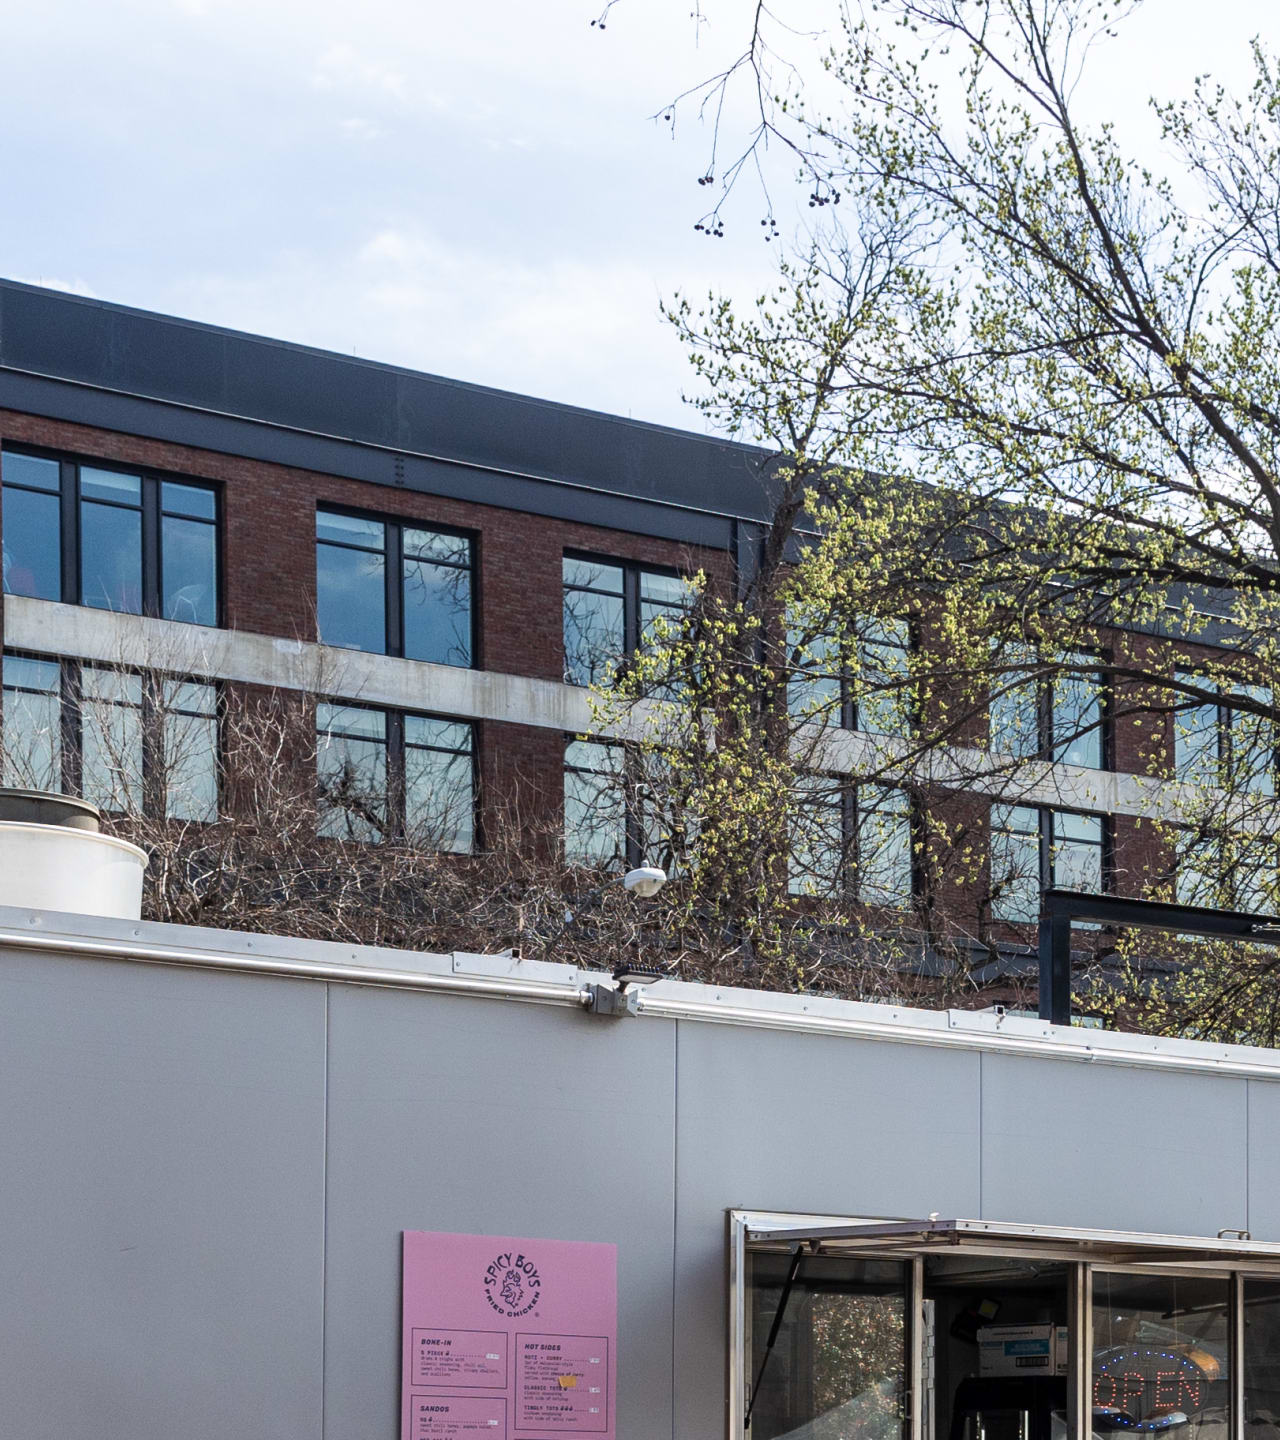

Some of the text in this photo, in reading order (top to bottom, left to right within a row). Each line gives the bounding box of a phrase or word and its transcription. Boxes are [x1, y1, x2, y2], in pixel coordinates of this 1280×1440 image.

[484, 1252, 541, 1288] SPICY BOYS
[484, 1289, 541, 1317] FRIED CHICKEN
[1094, 1371, 1200, 1408] OPEN
